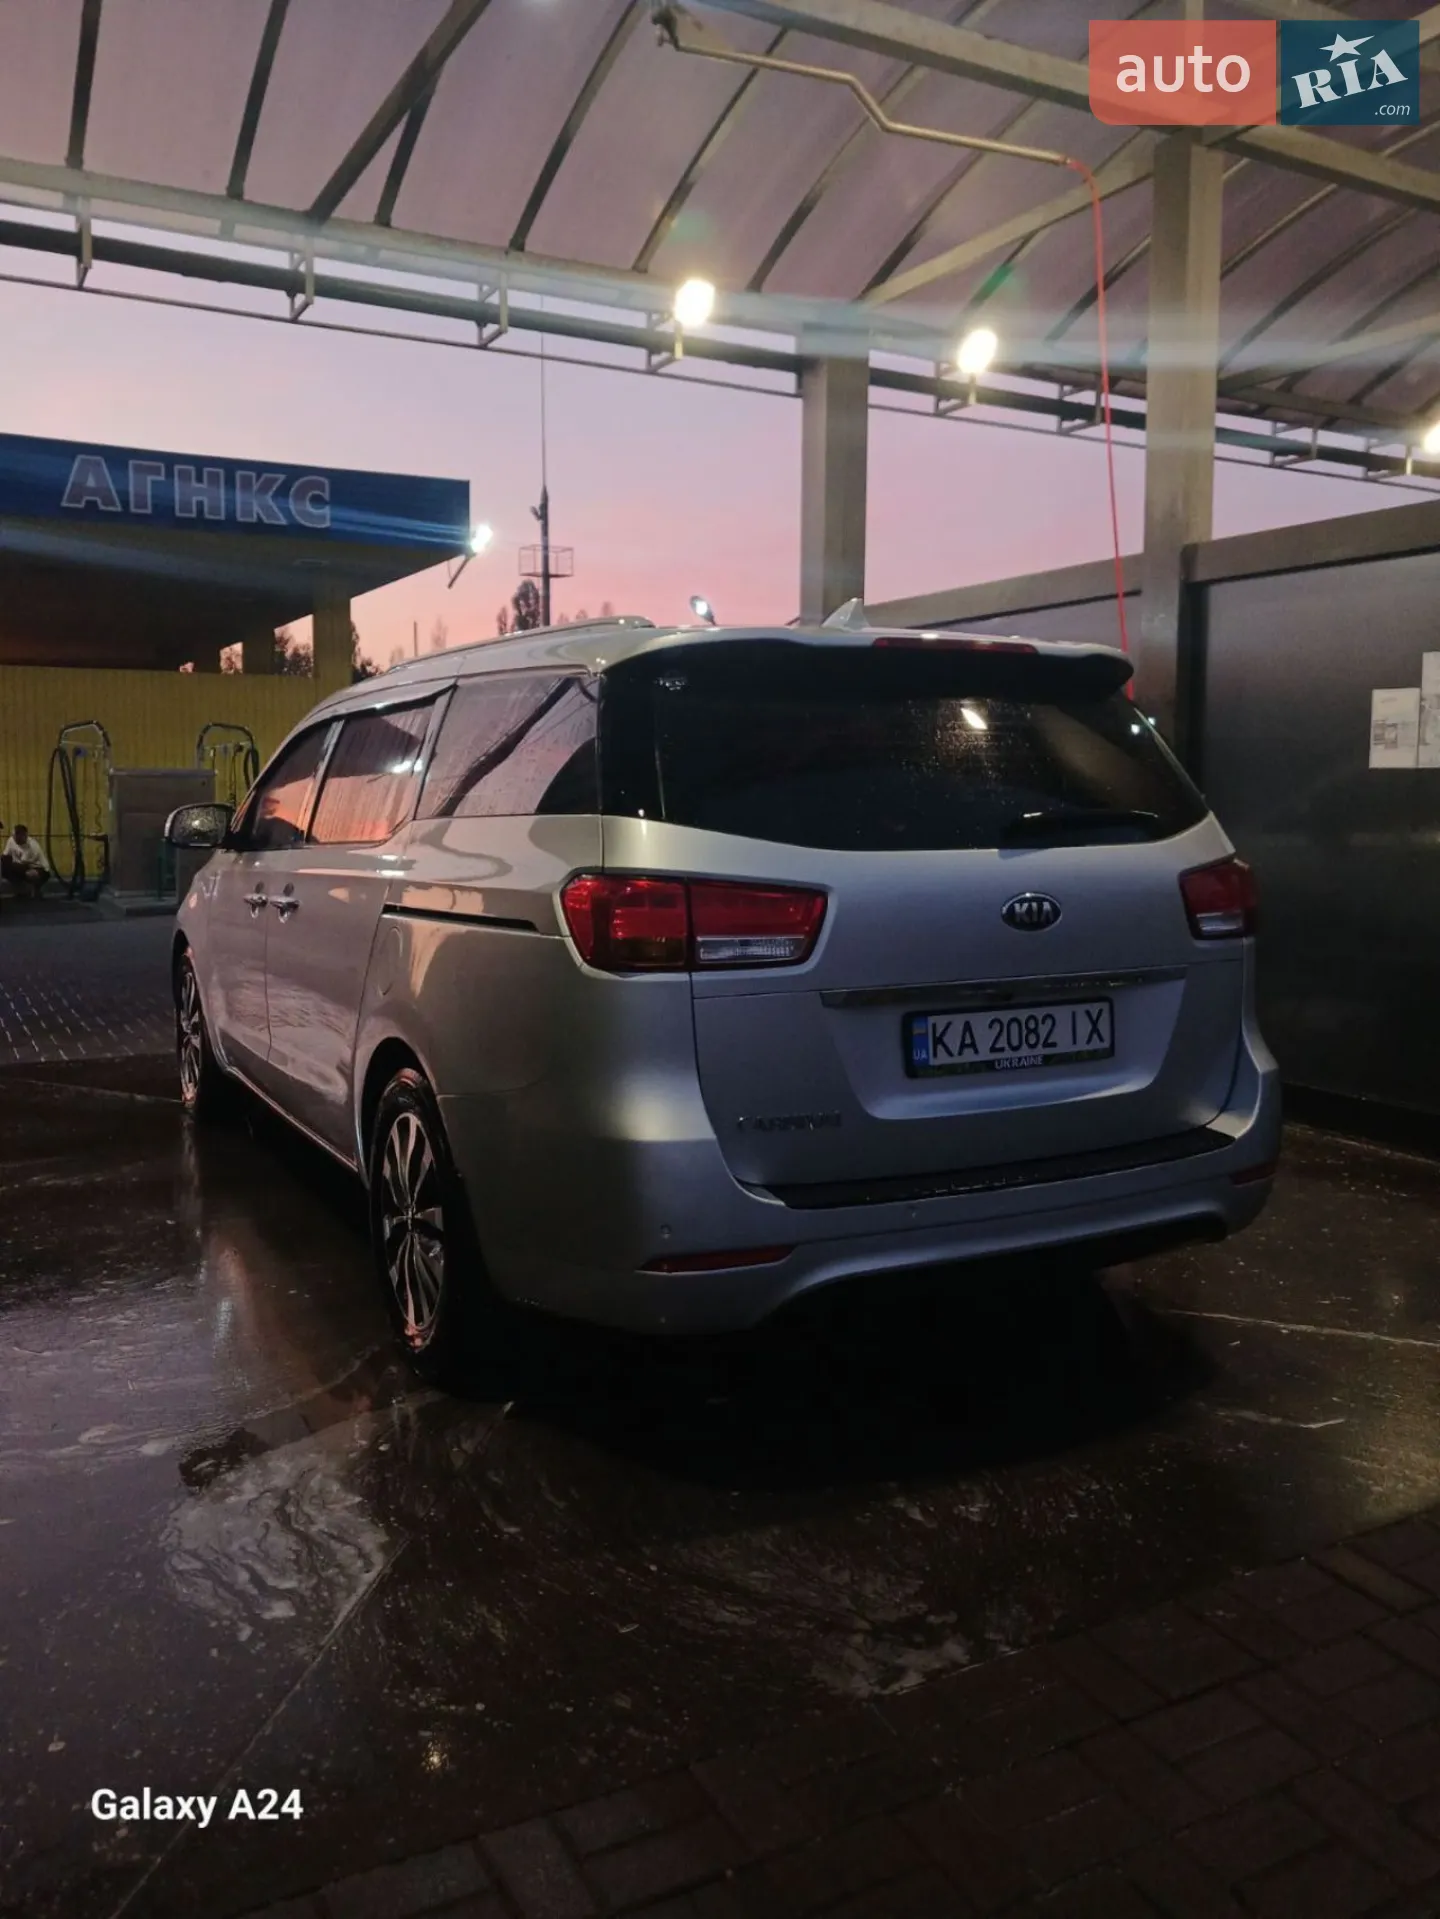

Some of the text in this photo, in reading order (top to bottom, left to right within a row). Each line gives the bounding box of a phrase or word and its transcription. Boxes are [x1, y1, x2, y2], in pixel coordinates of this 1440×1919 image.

[60, 454, 331, 528] АГНКС
[1014, 901, 1052, 922] KIA
[932, 1008, 1105, 1059] KA 2082 IX
[912, 1050, 928, 1061] UA
[995, 1054, 1044, 1070] UKRAINE
